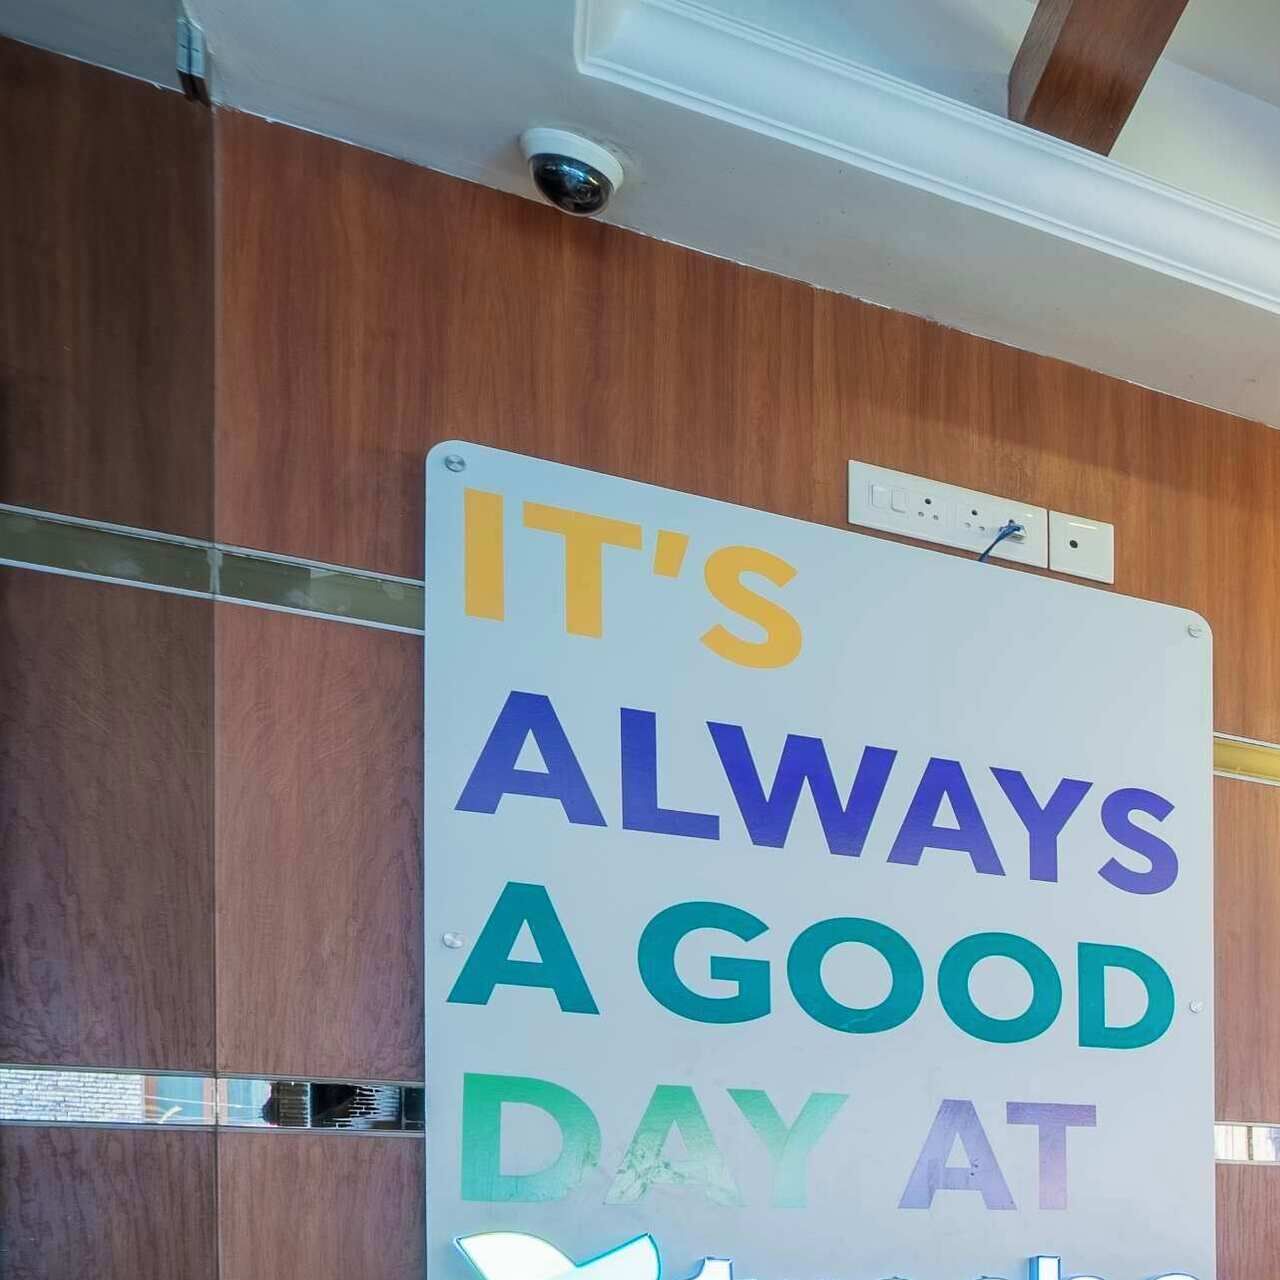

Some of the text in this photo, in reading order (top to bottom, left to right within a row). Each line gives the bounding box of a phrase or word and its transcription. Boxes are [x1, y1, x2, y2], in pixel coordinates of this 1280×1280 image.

[463, 489, 802, 670] IT'S
[453, 689, 1180, 896] ALWAYS
[446, 880, 1175, 1050] A GOOD
[461, 1072, 1097, 1212] DAY AT
